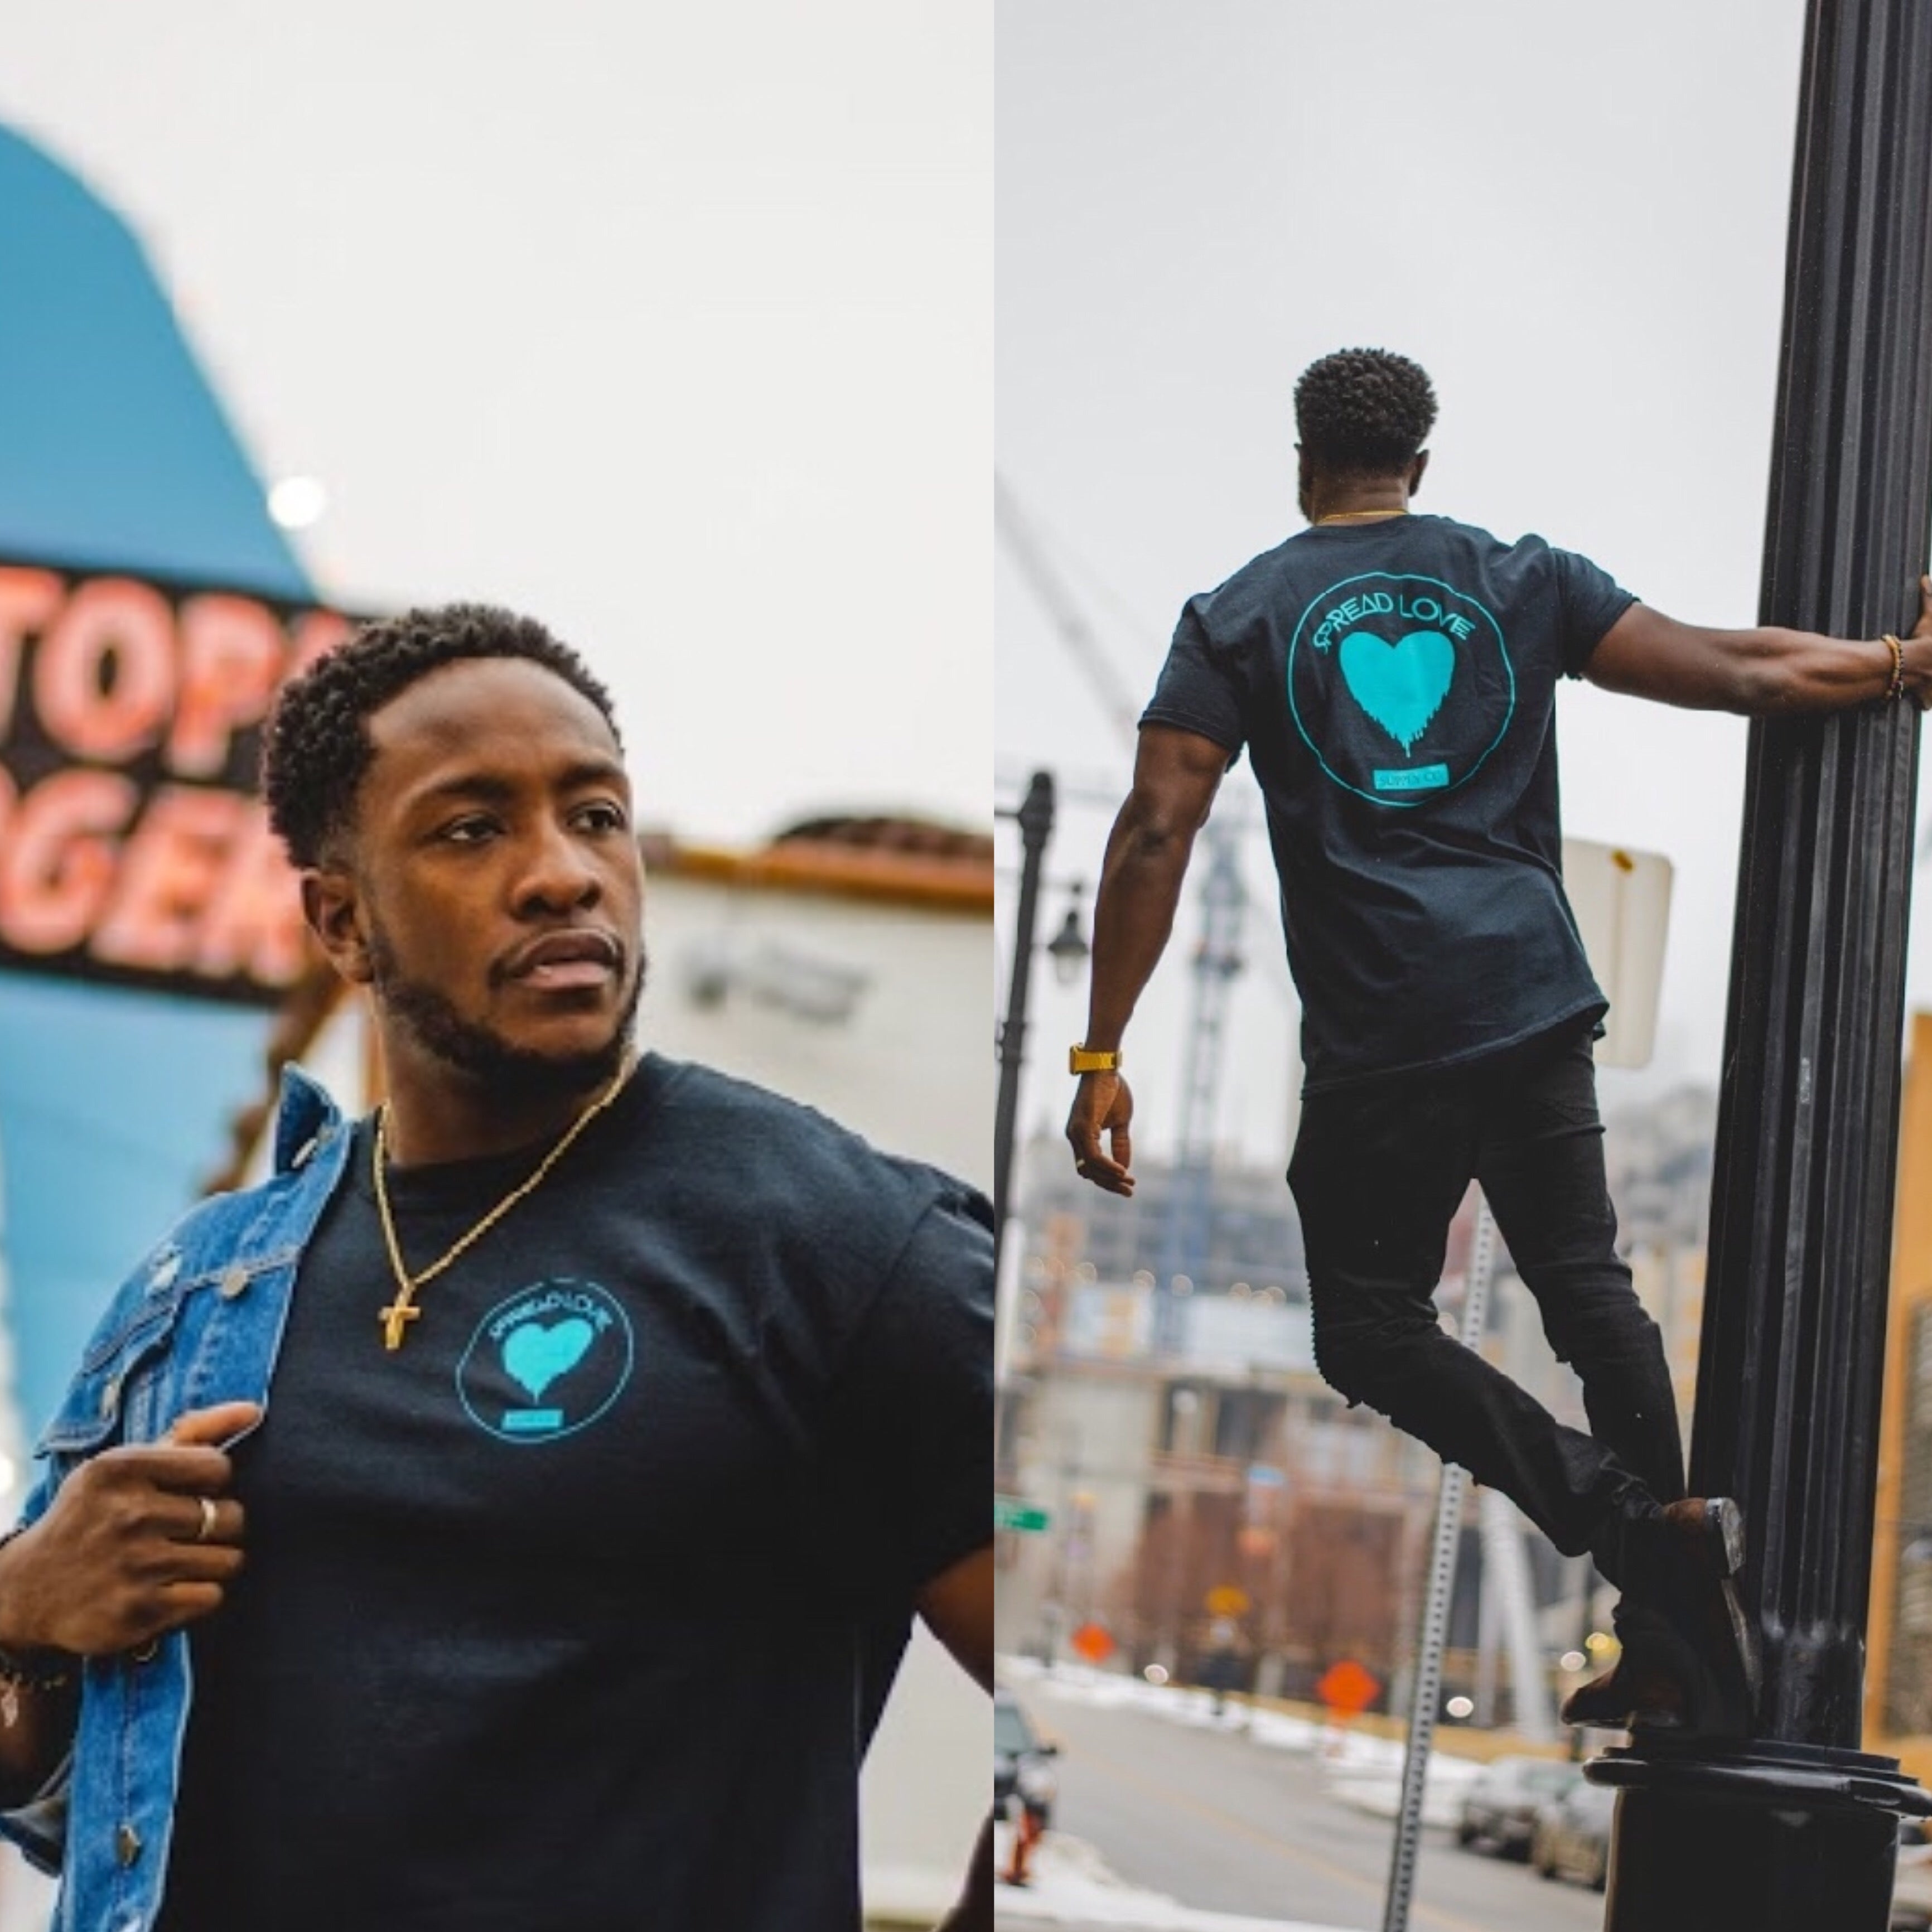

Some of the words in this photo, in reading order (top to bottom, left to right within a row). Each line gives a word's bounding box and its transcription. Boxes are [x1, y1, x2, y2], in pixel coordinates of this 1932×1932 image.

[1313, 592, 1394, 655] SPREAD
[1400, 594, 1476, 640] LOVE
[0, 762, 305, 985] GER
